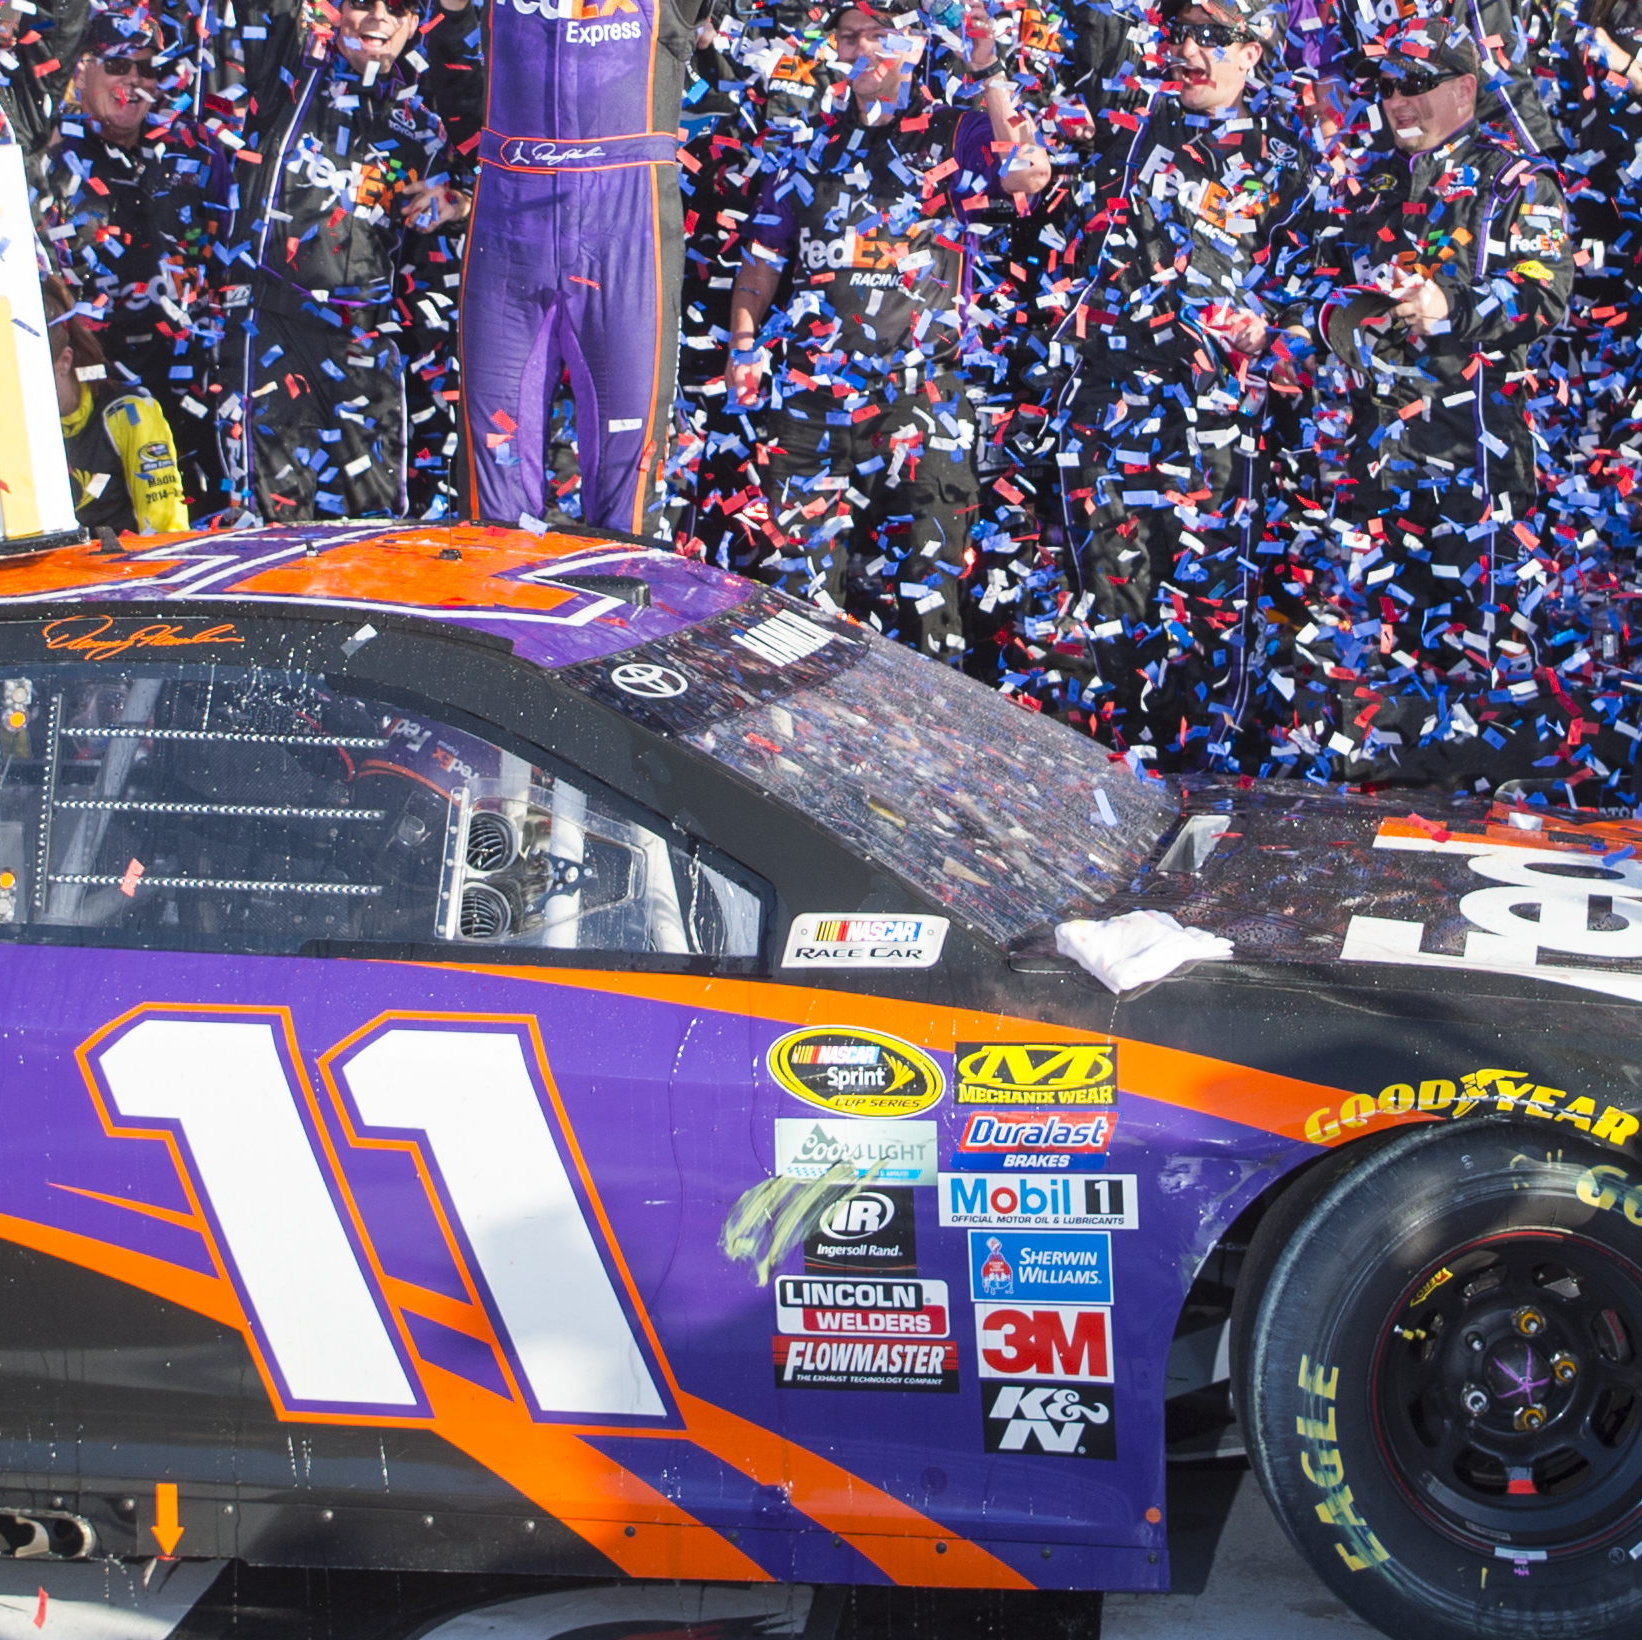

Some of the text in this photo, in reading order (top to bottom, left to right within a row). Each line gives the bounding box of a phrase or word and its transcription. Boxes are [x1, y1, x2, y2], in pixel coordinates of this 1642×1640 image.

[565, 20, 642, 47] Express
[847, 921, 921, 942] NASCAR
[795, 946, 924, 960] RACE CAR
[817, 1045, 880, 1064] NASCAR
[827, 1062, 887, 1090] Sprint
[834, 1097, 922, 1109] CUP SERIES
[959, 1084, 1114, 1104] MECHANIX WEAR
[1305, 1068, 1640, 1146] GOODYEAR
[970, 1118, 1108, 1147] Duralast
[801, 1133, 928, 1161] Coors LIGHT
[1003, 1154, 1071, 1168] BRAKES
[950, 1178, 1071, 1215] Mobil
[77, 1002, 687, 1433] 11
[951, 1215, 1125, 1226] OFFICIAL MOTOR OIL & LUBRICANTS
[817, 1243, 900, 1257] Ingersoll Rand
[1019, 1247, 1098, 1266] SHERWIN
[1018, 1266, 1099, 1285] WILLIAMS
[785, 1282, 917, 1308] LINCOLN
[816, 1311, 932, 1333] WELDERS
[981, 1308, 1109, 1378] 3M
[783, 1341, 946, 1382] FLOWMASTER
[796, 1373, 943, 1386] THE EXHAUST TECHNOLOGY COMPANY
